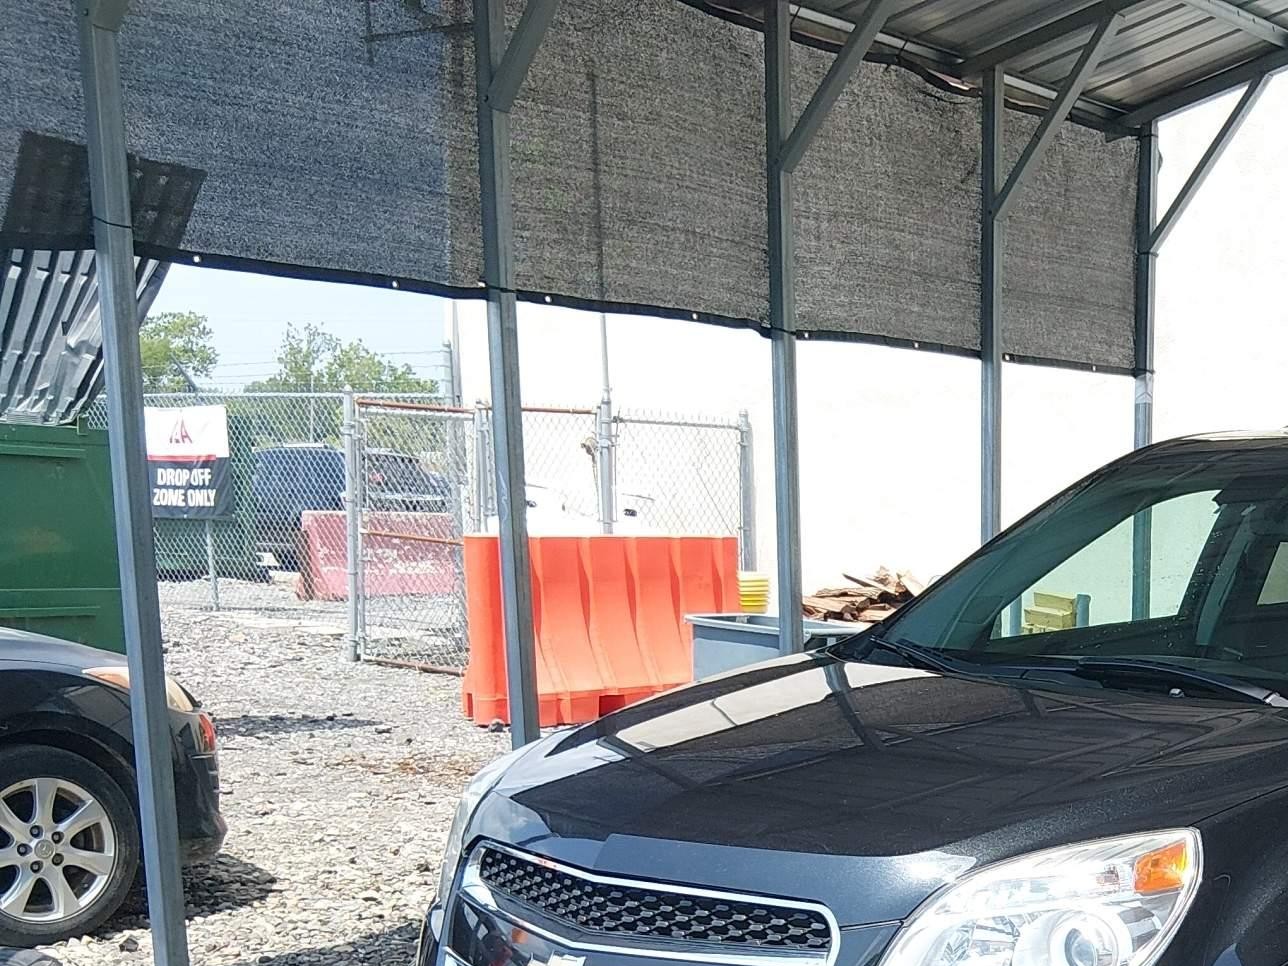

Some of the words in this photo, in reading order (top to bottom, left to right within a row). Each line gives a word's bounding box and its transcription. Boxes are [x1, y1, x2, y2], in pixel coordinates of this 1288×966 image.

[156, 468, 189, 486] DROP
[190, 468, 212, 486] OFF
[153, 488, 186, 506] ZONE
[187, 489, 216, 506] ONLY
